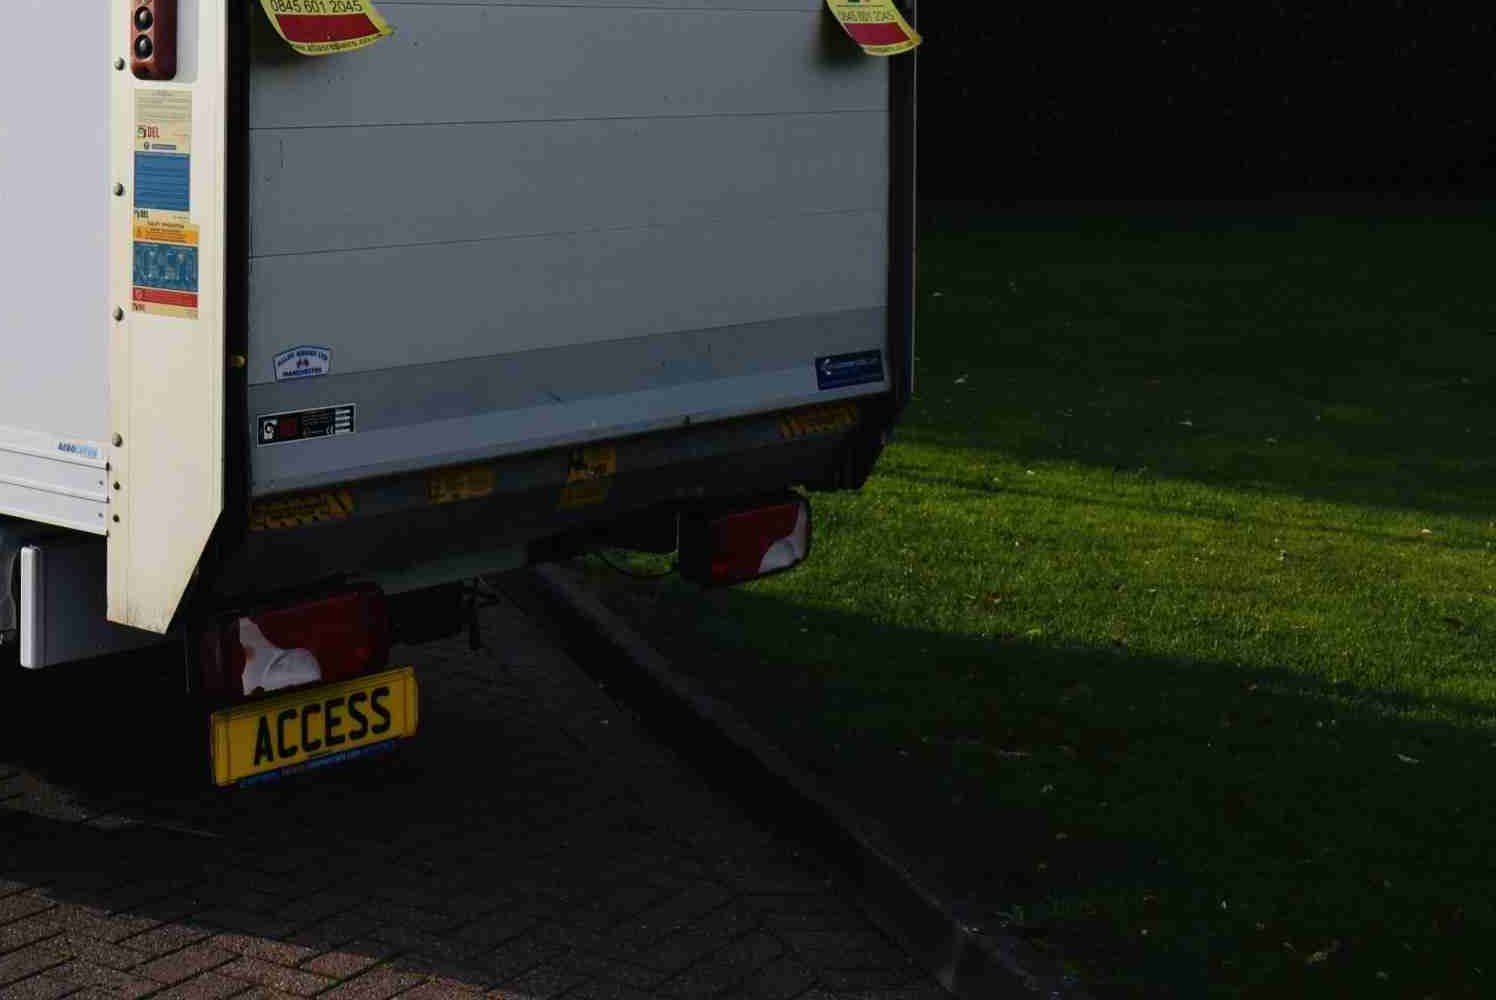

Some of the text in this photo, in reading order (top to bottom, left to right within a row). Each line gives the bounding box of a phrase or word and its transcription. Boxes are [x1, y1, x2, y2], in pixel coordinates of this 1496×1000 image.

[270, 0, 363, 13] 0845 601 2045
[253, 686, 391, 765] ACCESS
